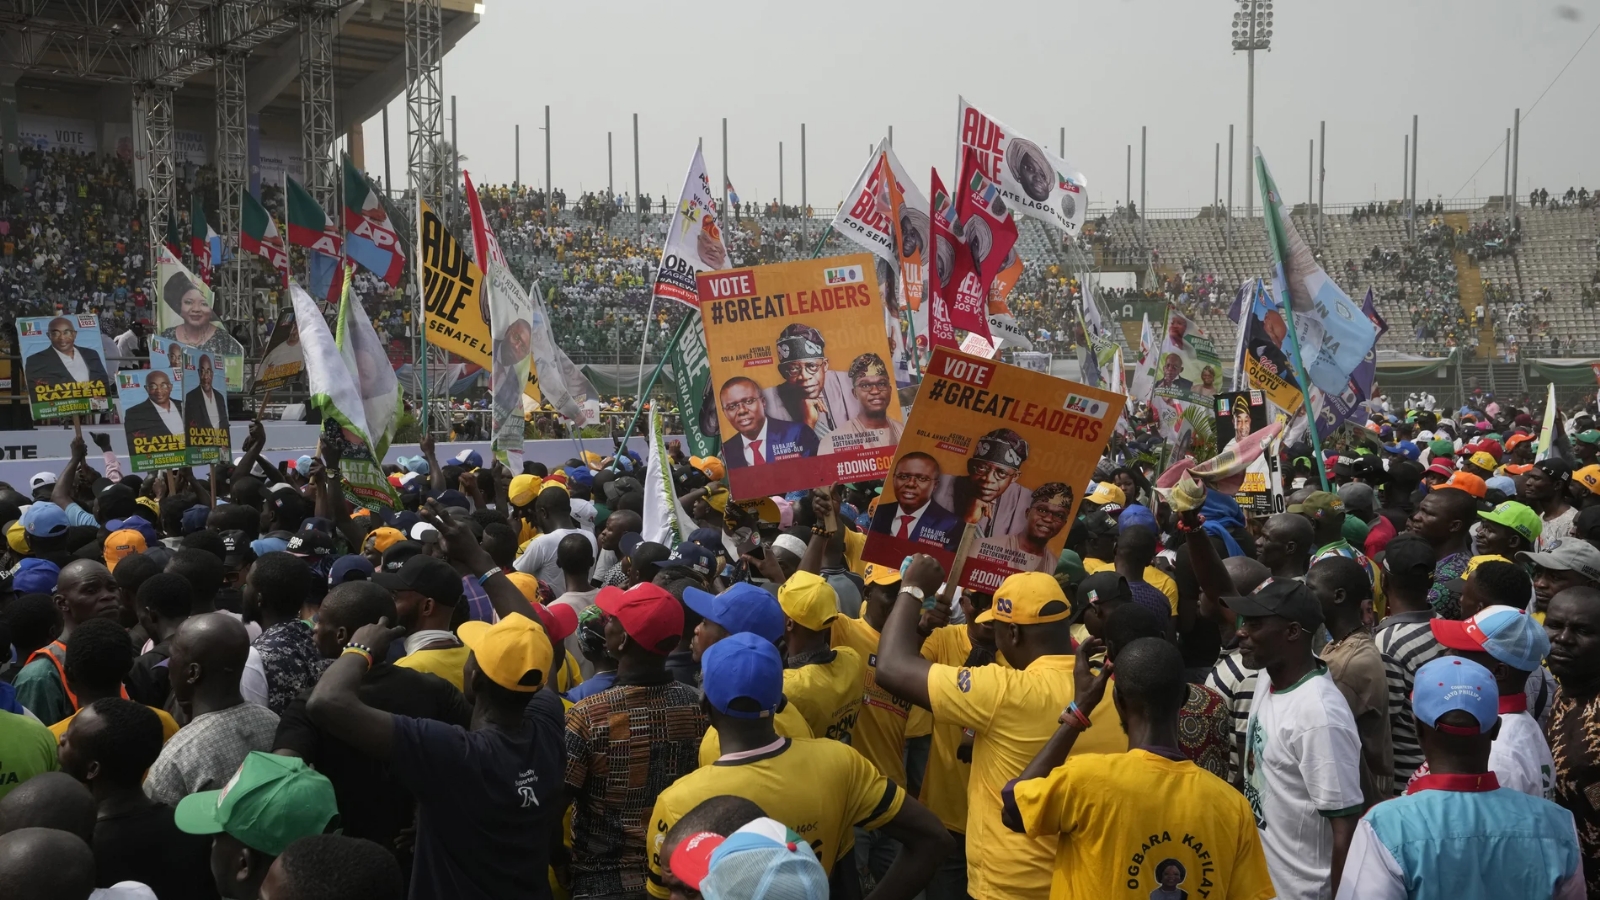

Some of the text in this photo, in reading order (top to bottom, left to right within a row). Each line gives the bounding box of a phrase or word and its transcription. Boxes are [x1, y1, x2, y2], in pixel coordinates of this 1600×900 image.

[55, 130, 84, 144] VOTE
[962, 107, 1005, 156] ADE
[1022, 198, 1055, 215] LAGOS
[843, 218, 895, 253] FOR SENA
[665, 254, 703, 280] OBA
[709, 275, 750, 298] VOTE
[1122, 304, 1133, 318] A
[429, 320, 479, 348] SENATE
[943, 356, 989, 385] VOTE
[1250, 366, 1279, 391] OLOTU
[35, 380, 105, 393] OLAYINKA
[37, 388, 106, 402] KAZEEM
[58, 403, 90, 412] ASSEMBLY
[677, 369, 709, 457] SENATE LAGOS
[134, 433, 185, 445] OLAYIN
[135, 442, 186, 454] KAZEE
[155, 455, 185, 464] ASSEMBLY
[981, 542, 1003, 553] SENATOR
[1127, 831, 1172, 890] OGBARA
[1182, 833, 1214, 899] KAFILAT
